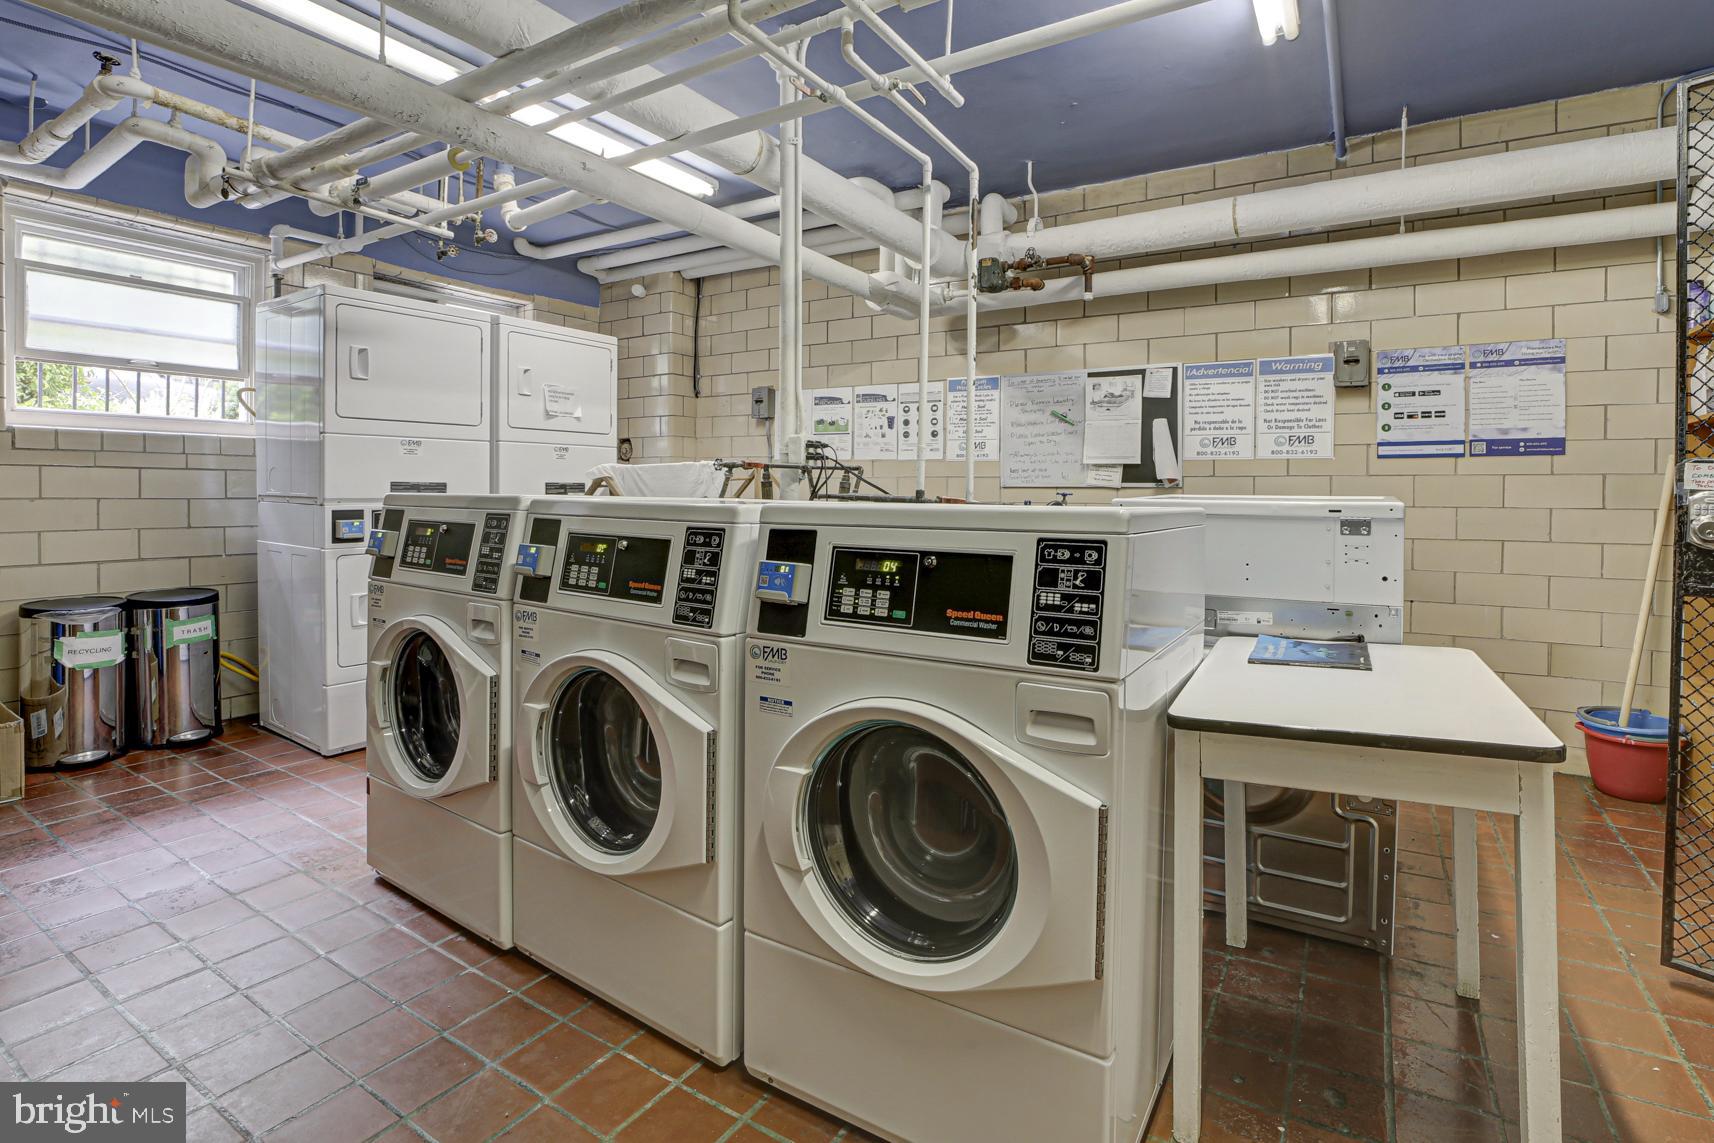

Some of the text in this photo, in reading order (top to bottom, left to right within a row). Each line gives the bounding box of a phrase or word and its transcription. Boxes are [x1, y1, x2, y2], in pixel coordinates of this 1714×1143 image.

[1272, 360, 1322, 371] Warning
[1212, 437, 1236, 448] FMB
[1288, 435, 1314, 447] FMB
[883, 562, 898, 572] 04
[523, 611, 537, 623] FMB
[946, 609, 1003, 621] Speed Queen
[950, 619, 978, 628] Commercial
[181, 625, 208, 636] TRASH
[67, 646, 112, 656] RECYCLING
[763, 646, 788, 661] FMB
